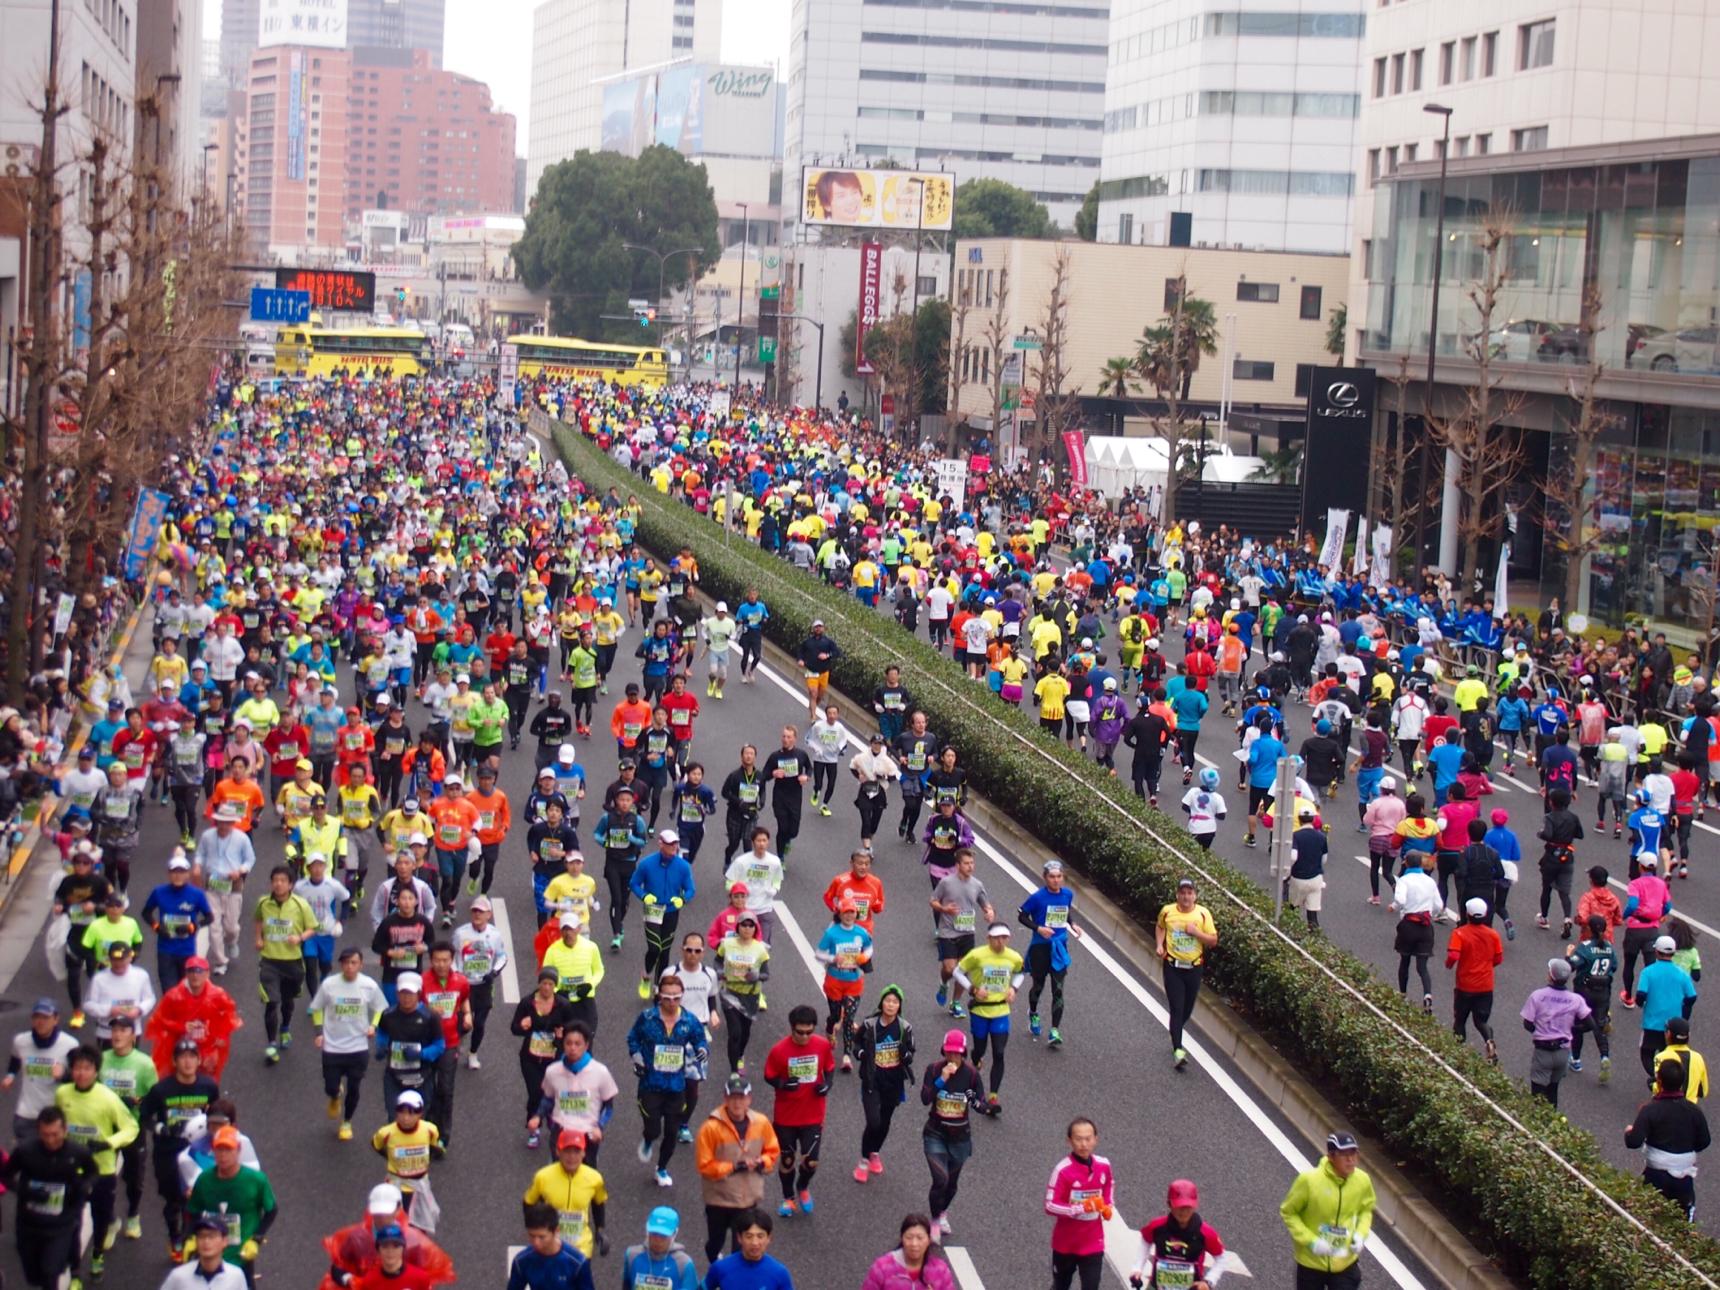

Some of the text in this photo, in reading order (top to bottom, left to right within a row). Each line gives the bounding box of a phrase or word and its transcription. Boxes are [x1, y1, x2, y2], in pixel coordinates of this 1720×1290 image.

[707, 70, 772, 96] Wing
[1317, 408, 1366, 418] LEXUS
[1590, 958, 1610, 976] 43
